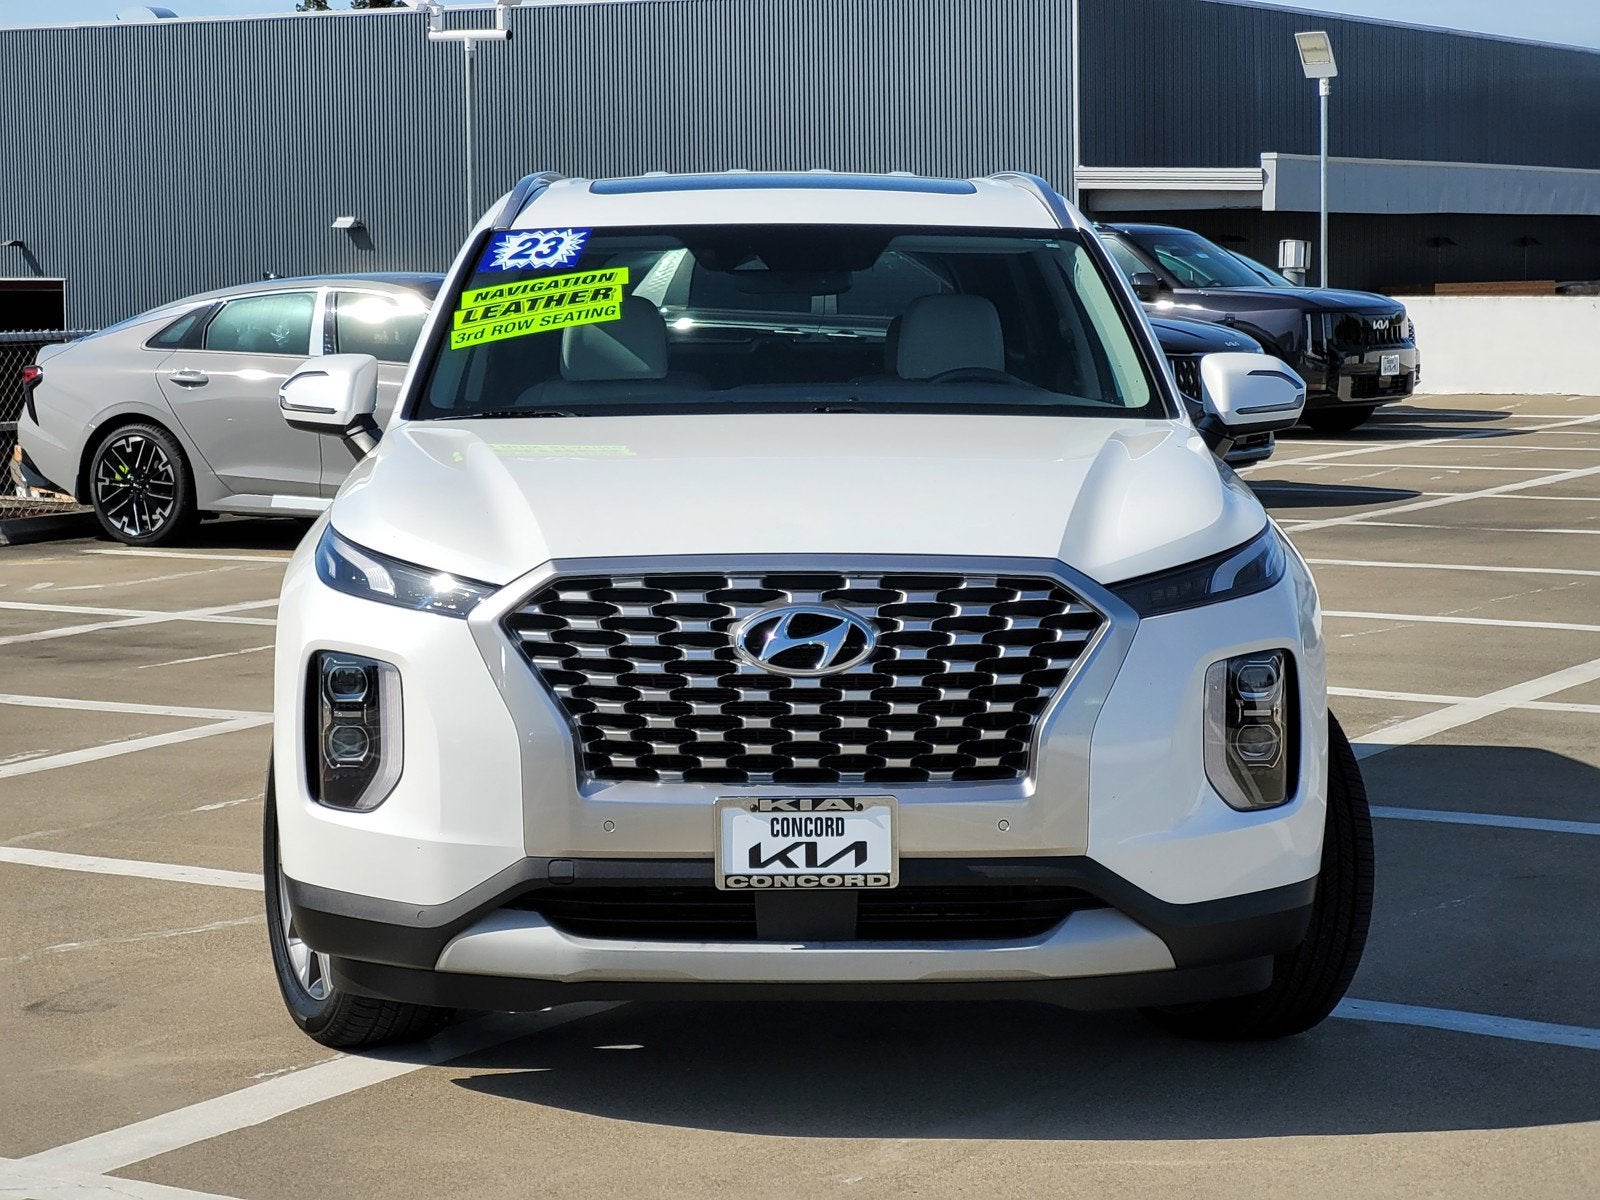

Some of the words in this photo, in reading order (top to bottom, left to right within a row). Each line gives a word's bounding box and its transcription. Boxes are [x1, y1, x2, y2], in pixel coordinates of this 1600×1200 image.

[508, 237, 565, 261] 23
[473, 271, 617, 303] NAVIGATION
[461, 286, 616, 325] LEATHER
[454, 327, 486, 345] 3rd
[491, 317, 535, 337] ROW
[539, 304, 617, 328] SEATING
[758, 798, 854, 811] KIA
[770, 816, 845, 838] CONCORD
[748, 840, 868, 869] KIA
[726, 874, 890, 888] CONCORD
